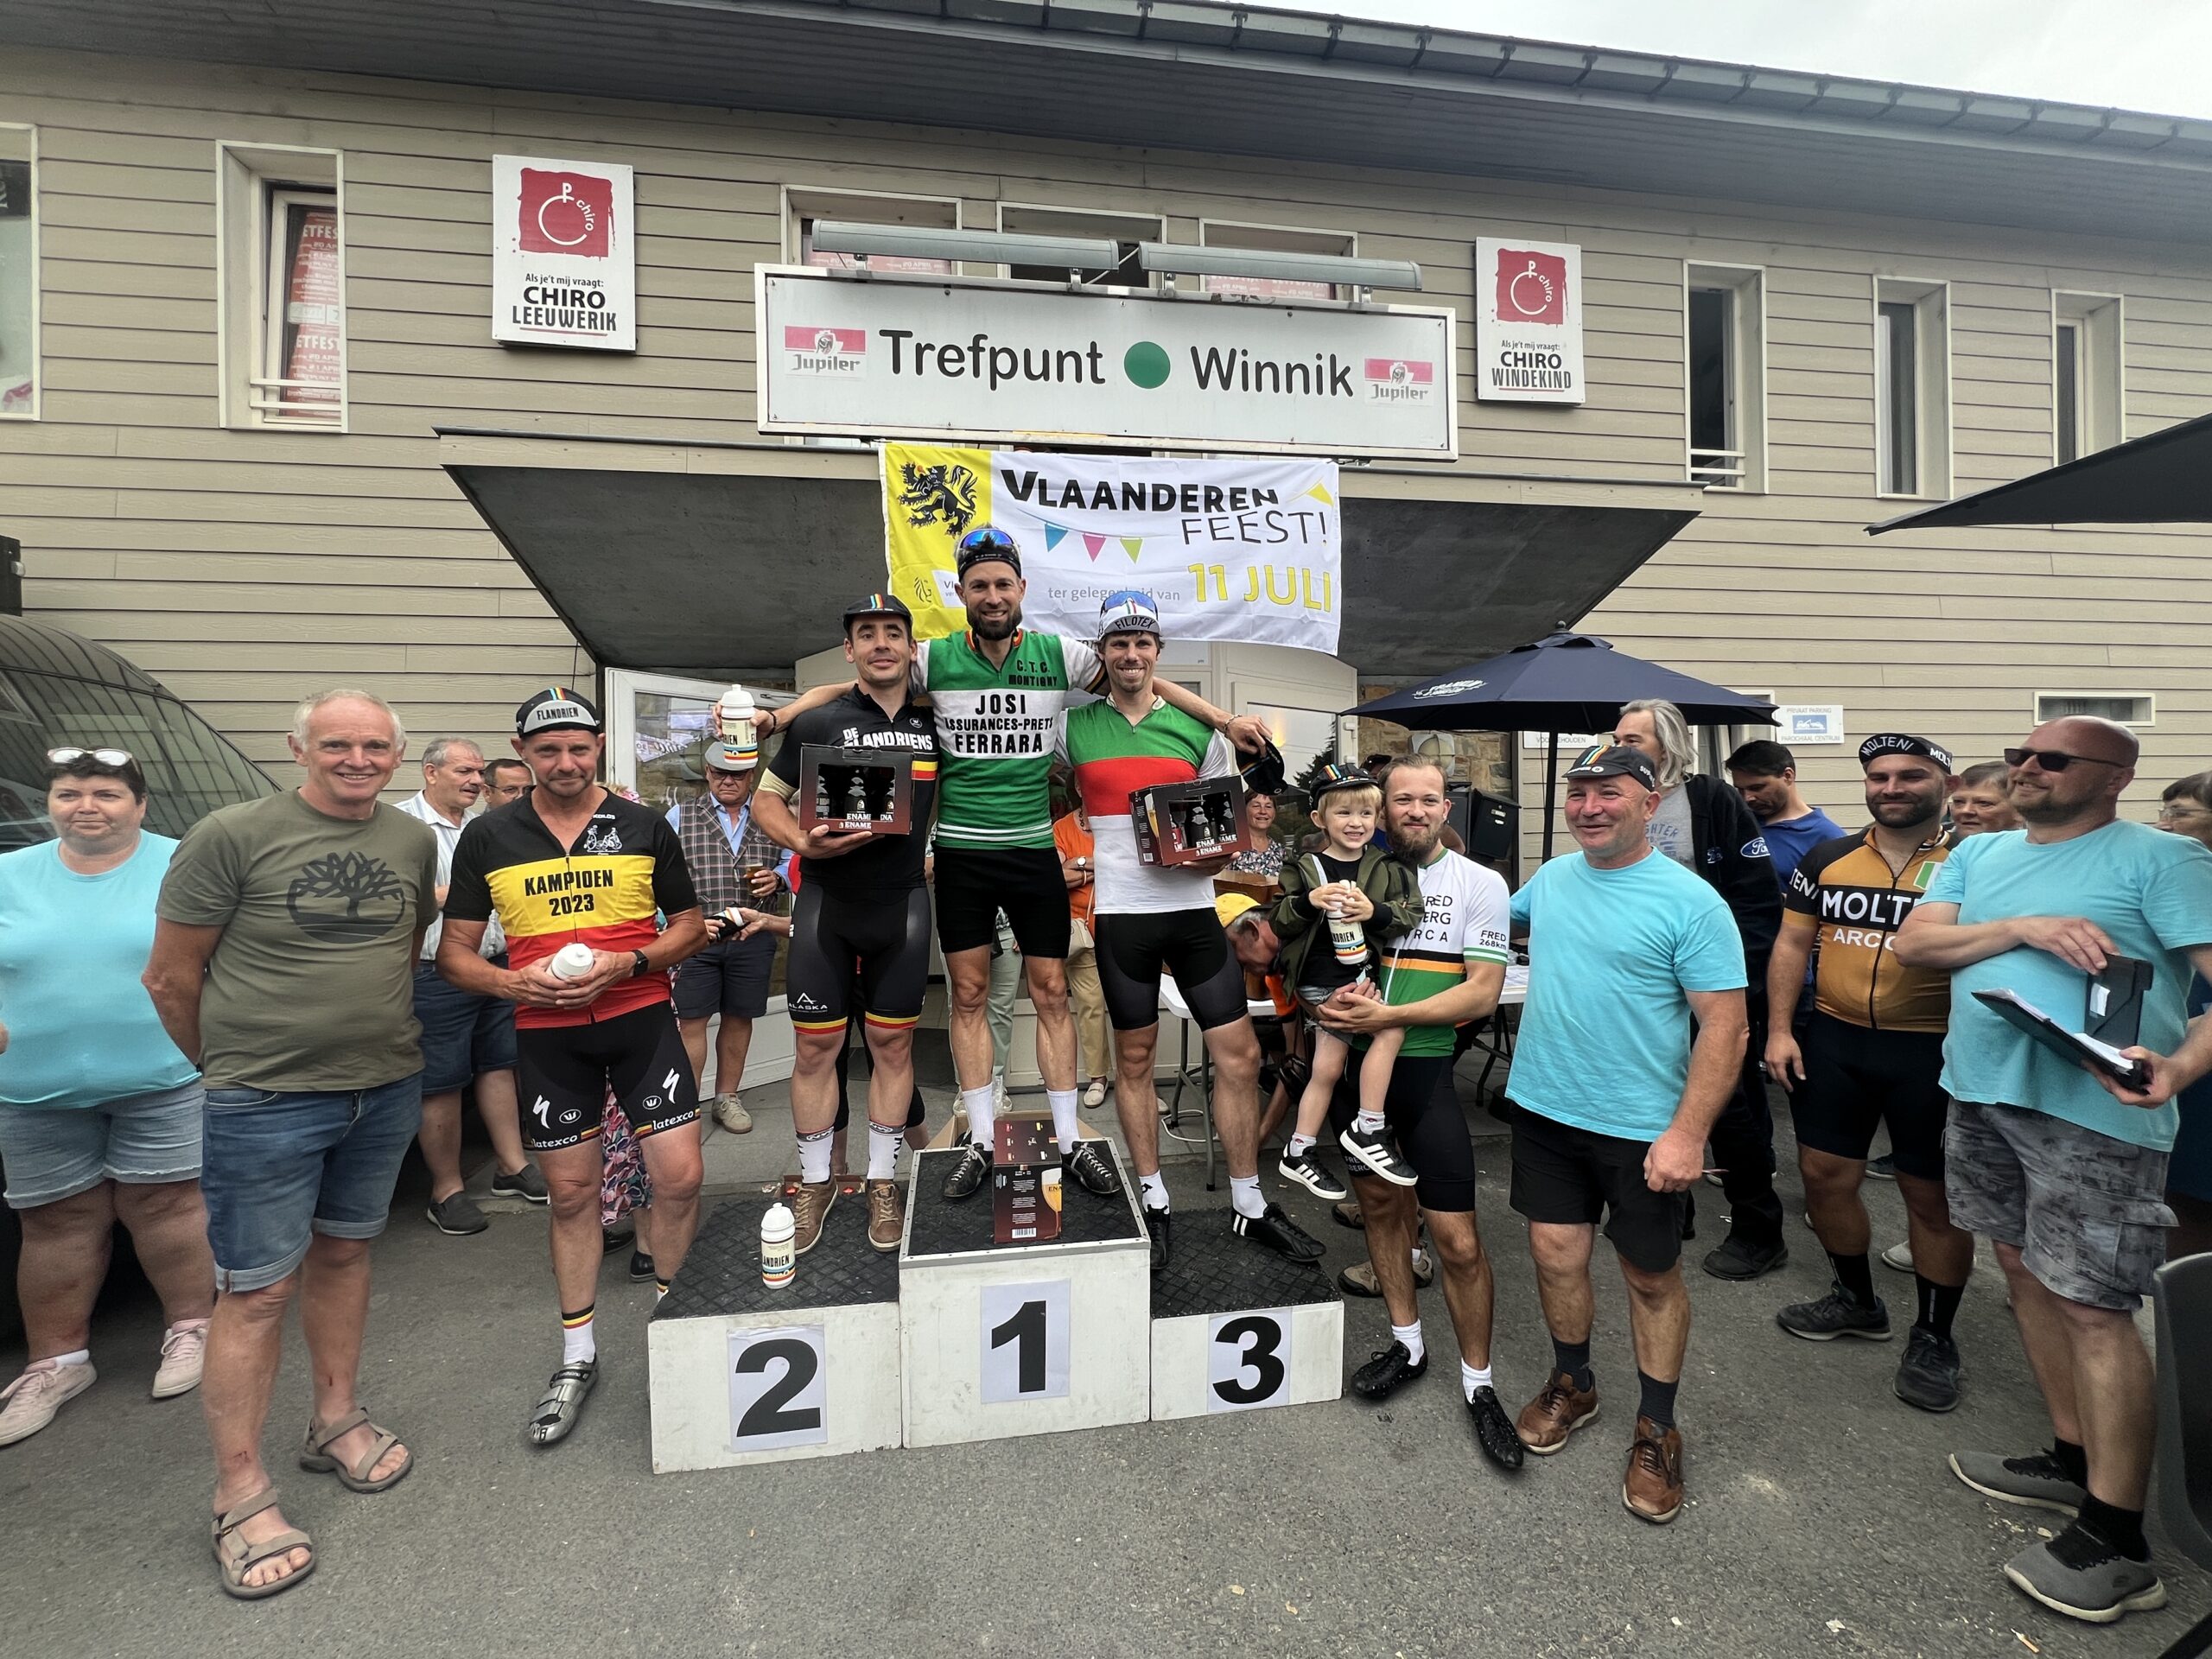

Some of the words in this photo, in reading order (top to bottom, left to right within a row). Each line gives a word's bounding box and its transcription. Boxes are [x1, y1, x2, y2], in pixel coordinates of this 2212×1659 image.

[575, 199, 595, 232] chiro
[525, 273, 538, 283] Als
[556, 276, 570, 286] mij
[573, 279, 604, 289] vraagt:
[1538, 275, 1553, 302] chiro
[523, 286, 606, 308] CHIRO
[512, 305, 617, 331] LEEUWERIK
[1524, 342, 1535, 351] mij
[1536, 343, 1560, 352] vraagt:
[791, 353, 861, 373] Jupiler
[879, 328, 1106, 391] Trefpunt
[1190, 346, 1354, 397] Winnik
[1500, 351, 1562, 369] CHIRO
[1491, 367, 1572, 389] WINDEKIND
[1370, 383, 1429, 402] Jupiler
[1000, 468, 1279, 514] VLAANDEREN
[1181, 509, 1328, 546] FEEST!
[1047, 586, 1068, 599] ter
[1071, 585, 1154, 603] gelegeid
[1158, 588, 1181, 601] van
[1187, 562, 1230, 603] 11
[1243, 563, 1332, 613] JULI
[1114, 615, 1156, 630] FILOTEX
[1008, 674, 1058, 687] MONTIGNY
[537, 706, 580, 721] FLANDRIEN
[975, 694, 1027, 715] JOSI
[842, 727, 860, 741] DE
[954, 733, 1043, 754] FERRARA
[1860, 735, 1915, 757] MOLTENI
[844, 821, 872, 830] ENAME
[1200, 845, 1223, 855] ENAME
[524, 869, 614, 897] KAMPIOEN
[549, 893, 595, 917] 2023
[1423, 894, 1453, 907] RED
[1821, 890, 1922, 926] MOLT
[1422, 911, 1452, 925] ERG
[1478, 938, 1507, 950] 268km
[1480, 930, 1507, 942] FRED
[653, 1110, 695, 1131] latexco
[531, 1134, 578, 1149] latexco
[990, 1300, 1047, 1394] 1
[1211, 1314, 1286, 1406] 3
[734, 1337, 822, 1439] 2
